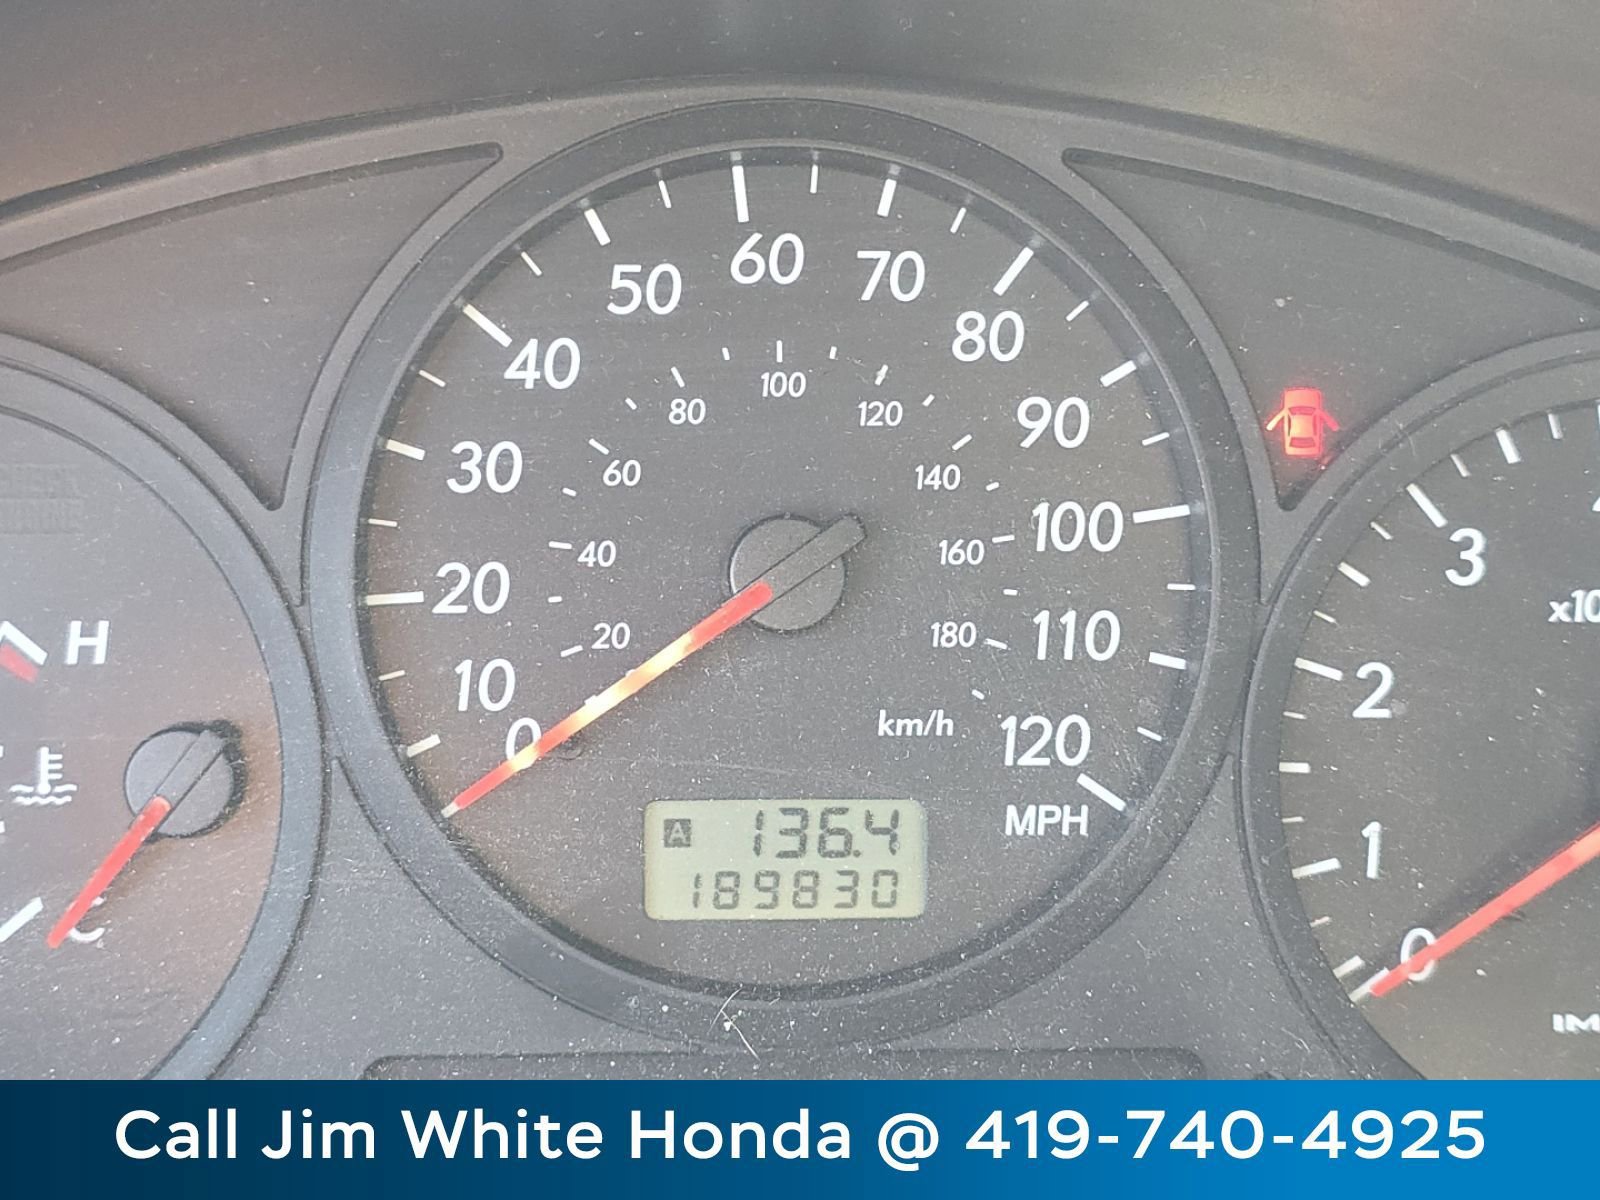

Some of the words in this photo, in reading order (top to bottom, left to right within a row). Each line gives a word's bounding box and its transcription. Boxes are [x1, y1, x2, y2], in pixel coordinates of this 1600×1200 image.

[730, 232, 805, 285] 60
[857, 249, 926, 301] 70
[607, 262, 682, 315] 50
[951, 310, 1025, 362] 80
[503, 337, 581, 390] 40
[760, 371, 807, 398] 100
[668, 397, 706, 425] 80
[857, 400, 904, 427] 120
[1016, 396, 1090, 449] 90
[446, 440, 523, 494] 30
[602, 459, 642, 487] 60
[914, 464, 961, 490] 140
[938, 539, 985, 565] 160
[1031, 501, 1125, 552] 100
[577, 540, 617, 568] 40
[1445, 528, 1487, 586] 3
[431, 561, 511, 615] 20
[65, 619, 109, 664] H
[591, 621, 631, 650] 20
[930, 621, 977, 648] 180
[1032, 609, 1121, 661] 110
[454, 658, 516, 712] 10
[1352, 661, 1394, 719] 2
[505, 717, 542, 768] 0
[877, 709, 955, 737] km/h
[1000, 713, 1092, 767] 120
[752, 806, 900, 859] 136.4
[1004, 804, 1089, 837] MPH
[1360, 820, 1383, 879] 1
[692, 869, 900, 910] 189830
[1400, 927, 1438, 982] 0
